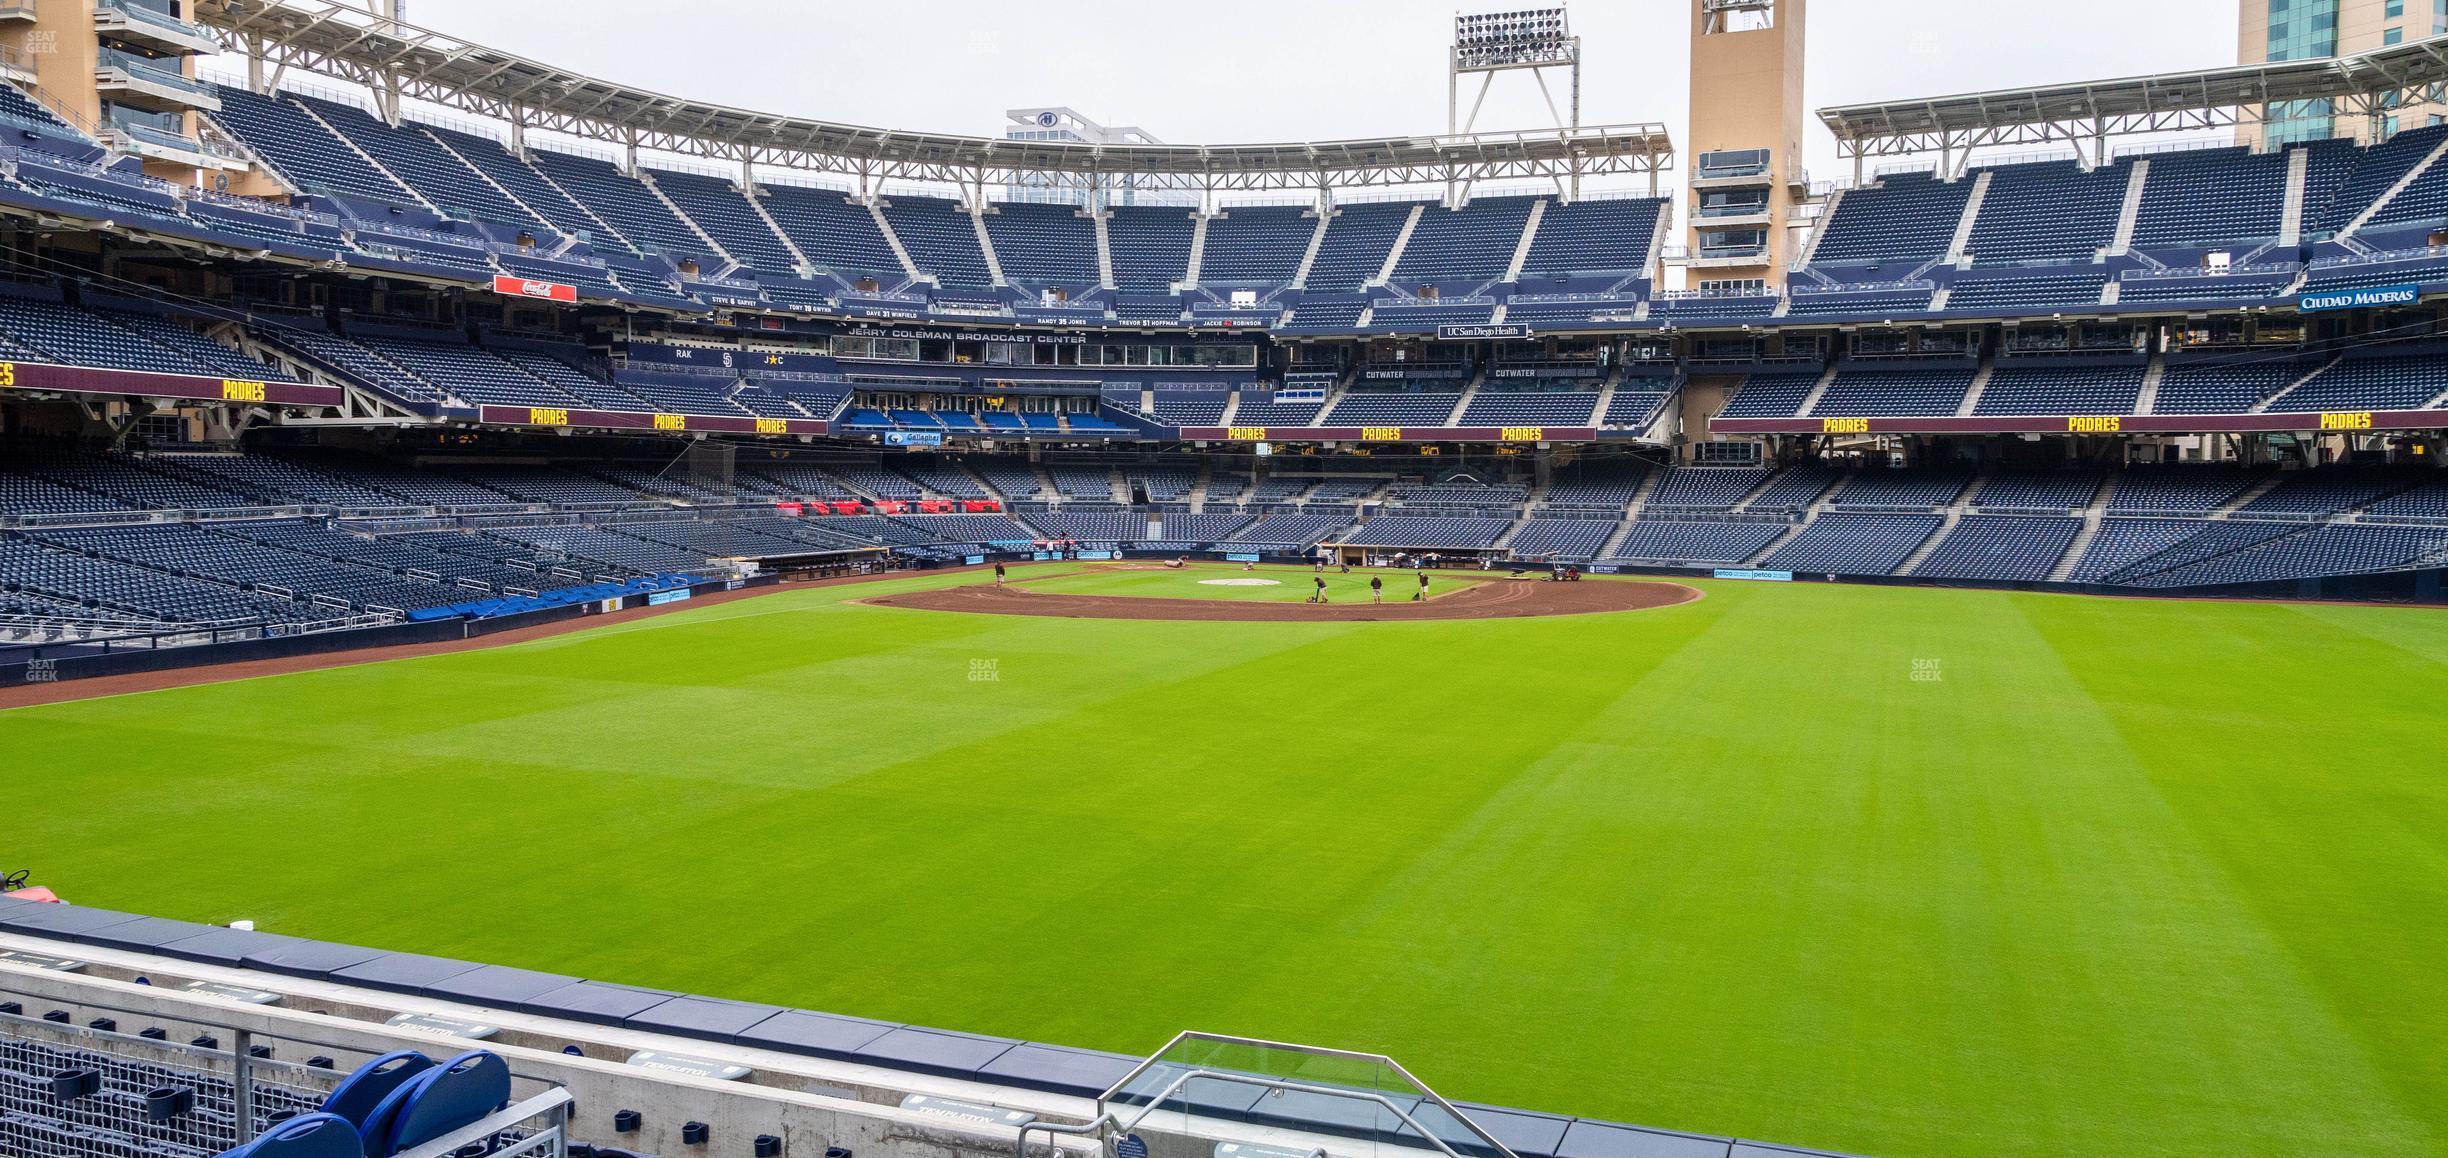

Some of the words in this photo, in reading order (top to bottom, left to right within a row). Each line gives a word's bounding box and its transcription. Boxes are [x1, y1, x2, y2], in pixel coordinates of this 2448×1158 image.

[712, 296, 728, 304] STEVE
[737, 299, 757, 307] GARVEY
[2302, 296, 2351, 309] CIUDAD
[2354, 290, 2414, 305] MADERAS
[789, 304, 803, 312] TONY
[805, 304, 812, 312] 19
[882, 310, 890, 318] 31
[891, 311, 918, 319] WINFIELD
[1068, 318, 1087, 326] JONES
[1142, 319, 1150, 327] 51
[849, 327, 887, 338] JERRY
[892, 329, 952, 340] COLEMAN
[956, 333, 1033, 344] BROADCAST
[1037, 335, 1087, 345] CENTER
[1447, 327, 1459, 336] UC
[1460, 327, 1473, 336] San
[1474, 327, 1494, 337] Diego
[1495, 326, 1518, 336] Health
[676, 349, 692, 359] RAK
[1366, 371, 1404, 379] CUTWATER
[1495, 369, 1535, 377] CUTWATER
[222, 380, 266, 401] PADRES
[530, 408, 568, 425] PADRES
[654, 414, 685, 430] PADRES
[2320, 412, 2371, 429] PADRES
[757, 418, 787, 433] PADRES
[1823, 418, 1869, 432] PADRES
[2068, 416, 2120, 432] PADRES
[1228, 427, 1266, 440] PADRES
[1362, 427, 1401, 441] PADRES
[1502, 427, 1542, 440] PADRES
[1715, 570, 1733, 578] petco
[1753, 571, 1772, 579] petco
[918, 1106, 994, 1124] TEMPLETON
